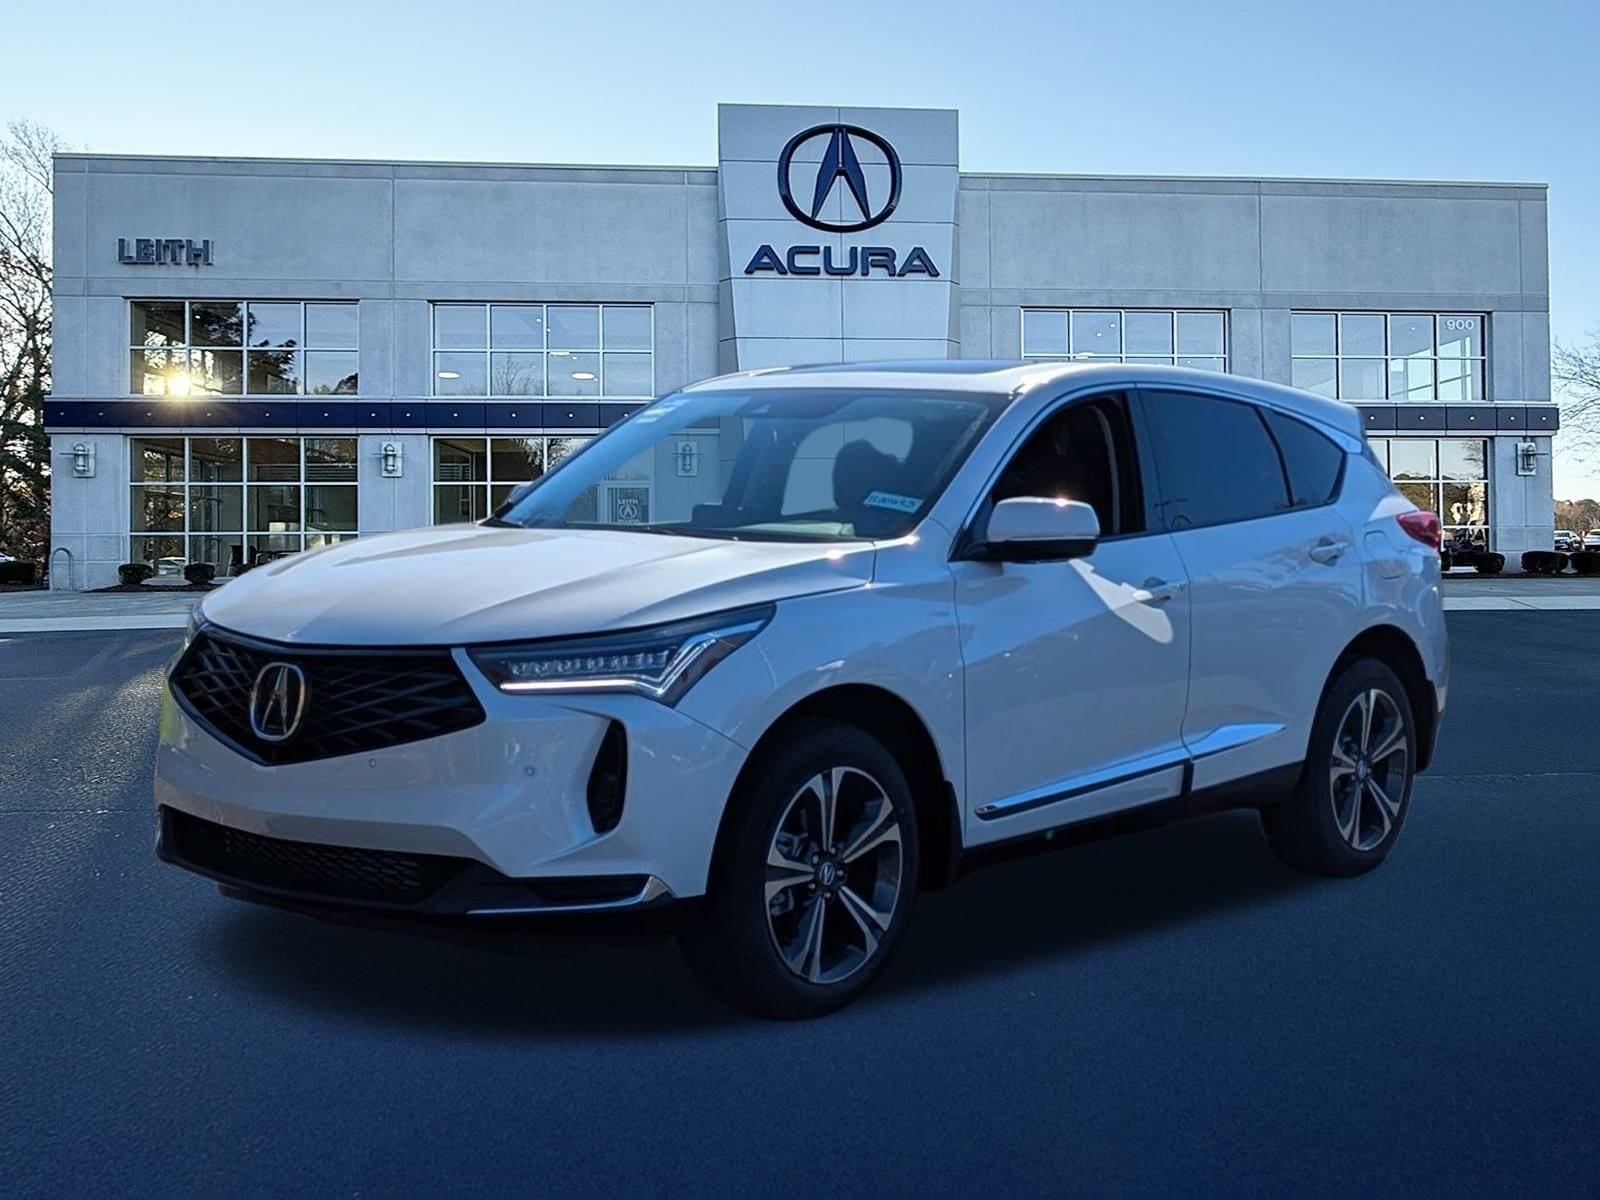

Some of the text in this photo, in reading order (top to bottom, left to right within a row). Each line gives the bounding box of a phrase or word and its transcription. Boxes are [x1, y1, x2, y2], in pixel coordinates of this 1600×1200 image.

[118, 238, 213, 265] LEITH
[744, 244, 940, 277] ACURA
[1446, 319, 1474, 330] 900
